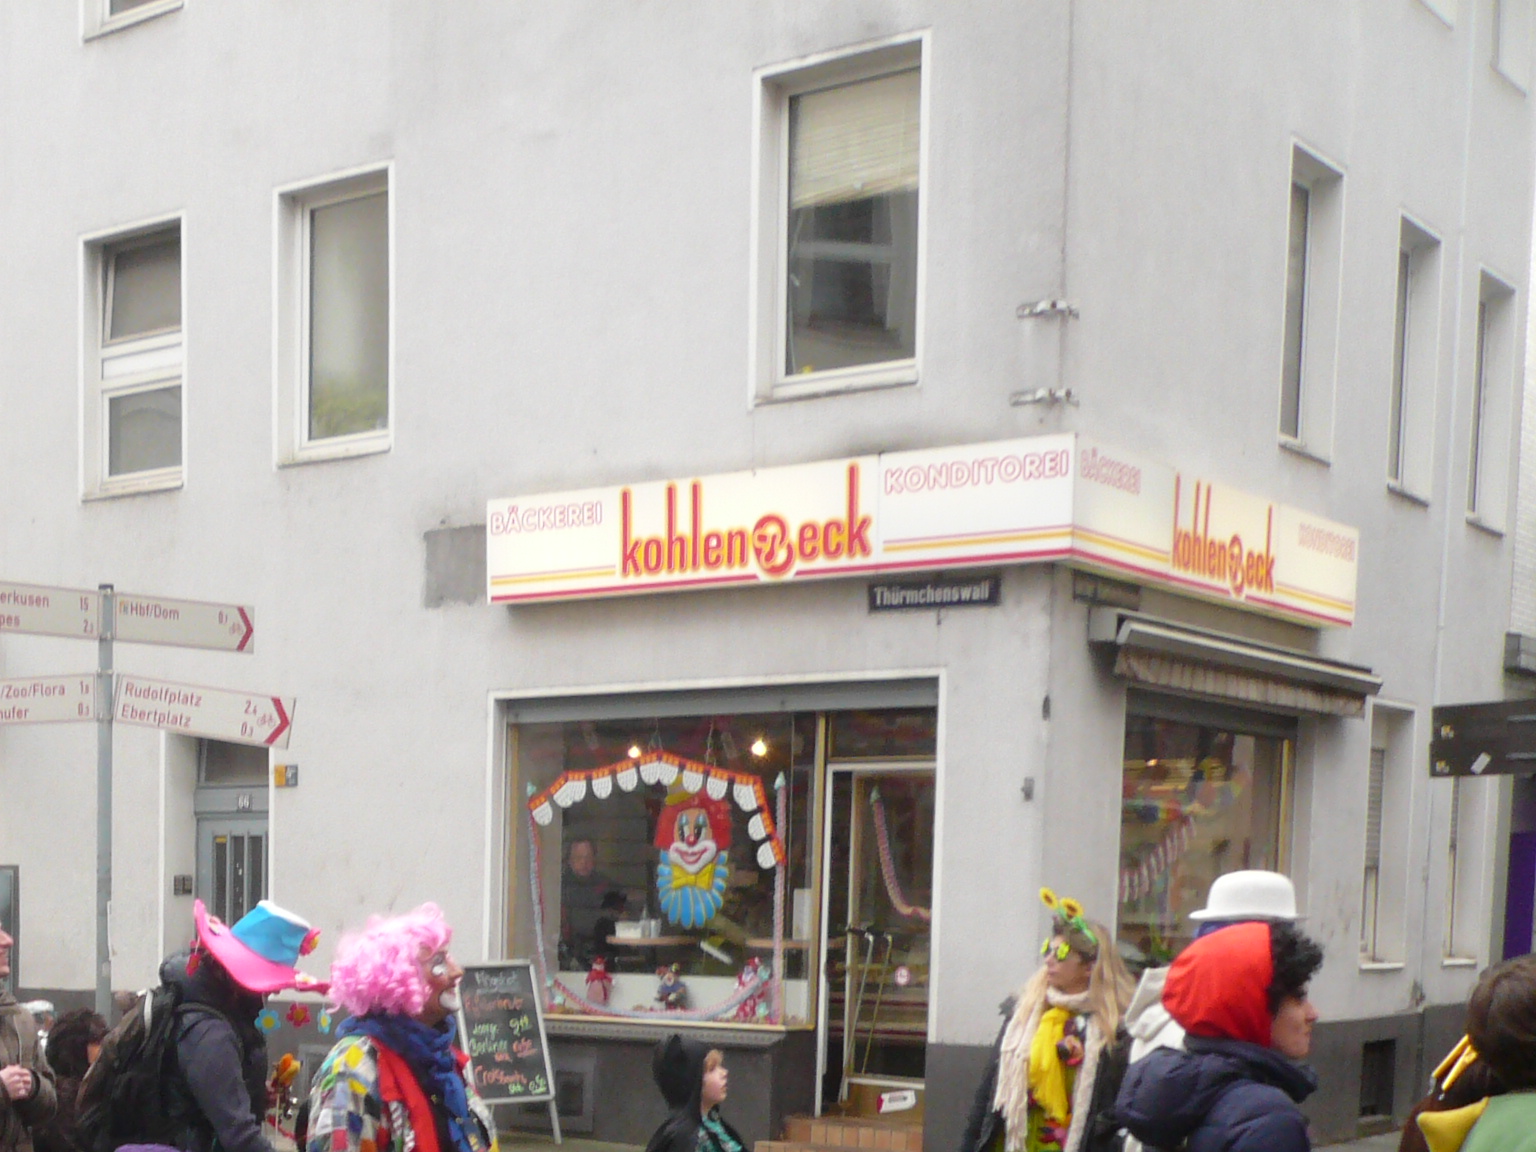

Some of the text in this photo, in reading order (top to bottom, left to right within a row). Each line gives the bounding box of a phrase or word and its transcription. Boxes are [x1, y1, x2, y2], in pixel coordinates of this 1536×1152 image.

[490, 501, 603, 535] BÄCKEREI
[884, 449, 1070, 496] KONDITOREI
[873, 579, 990, 606] Thürmchenswall
[130, 602, 180, 621] Hbf/Dom
[123, 682, 203, 708] Rudolfplatz
[121, 703, 191, 728] Ebertplatz
